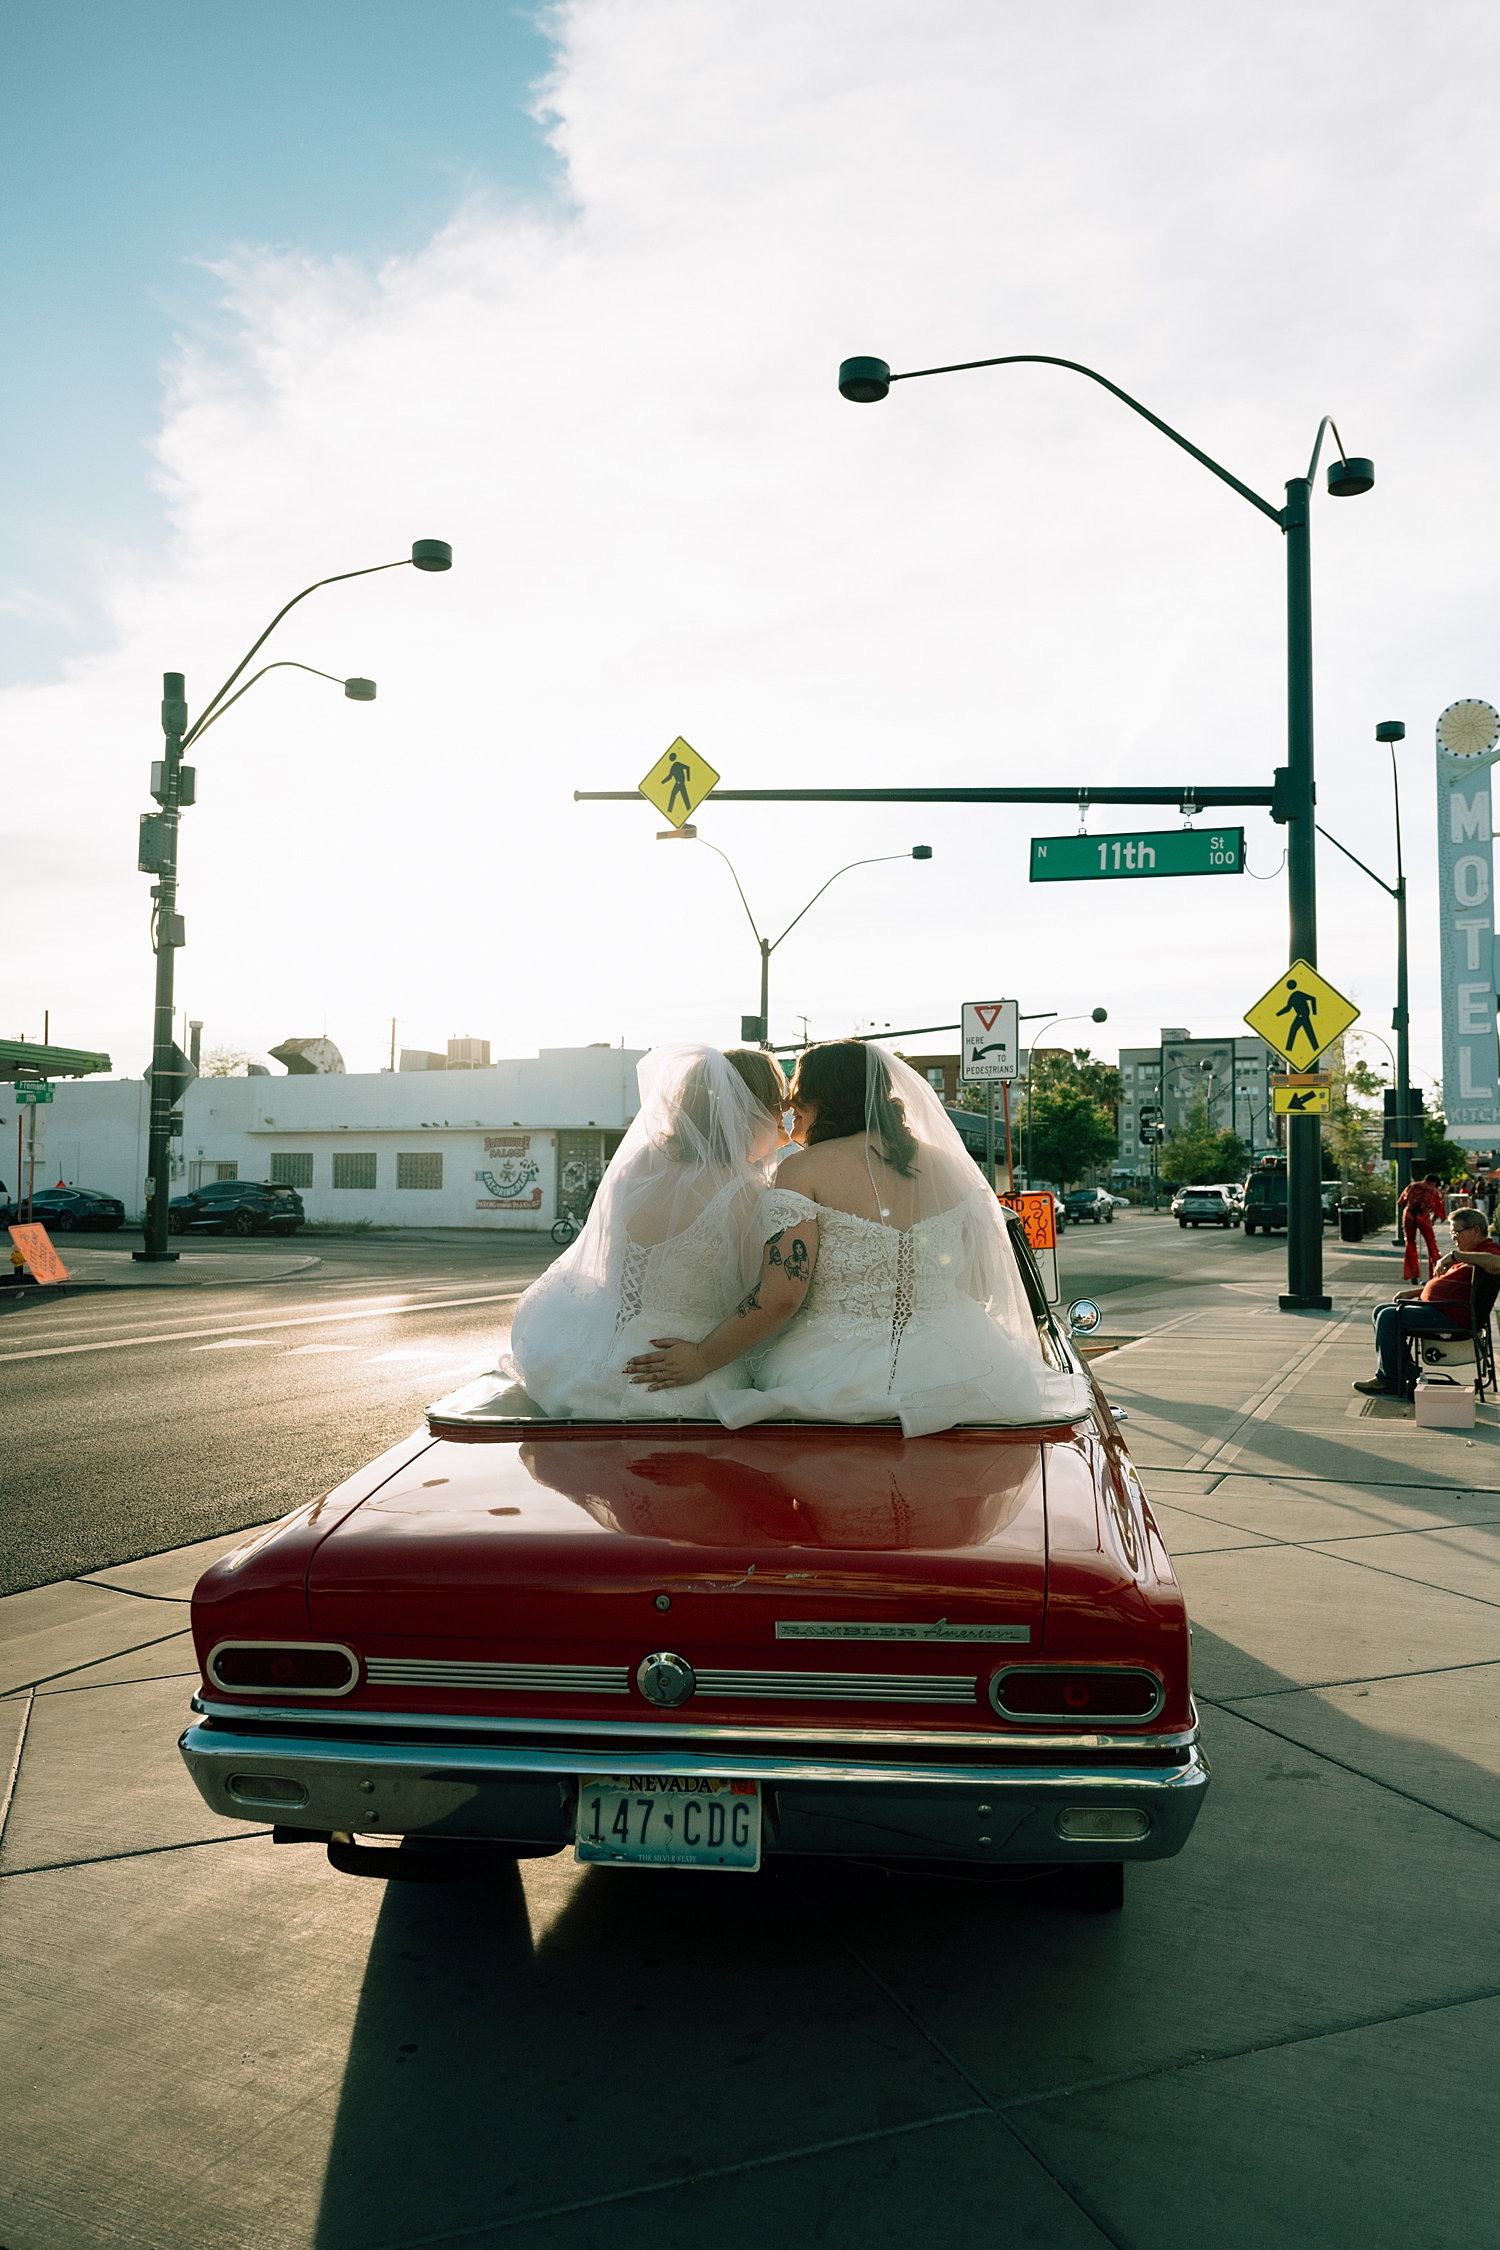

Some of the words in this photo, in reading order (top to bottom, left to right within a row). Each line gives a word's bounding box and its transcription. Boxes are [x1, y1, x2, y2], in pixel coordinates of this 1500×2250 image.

[1037, 846, 1047, 858] N
[1097, 841, 1156, 870] 11th
[1210, 837, 1225, 850] St
[1209, 851, 1235, 865] 100
[1451, 790, 1494, 1099] MOTEL
[965, 1036, 985, 1045] HERE
[997, 1054, 1007, 1062] TO
[965, 1065, 1014, 1075] PEDESTRIANS
[20, 1080, 47, 1091] Fremont
[490, 1148, 525, 1158] SALOON
[781, 1626, 917, 1637] RAMBLER
[923, 1617, 1020, 1639] American
[627, 1776, 714, 1793] NEVADA
[591, 1797, 654, 1844] 147
[683, 1800, 750, 1847] CDG
[638, 1854, 652, 1862] THE
[653, 1854, 676, 1862] SILVER
[677, 1855, 698, 1863] STATE
